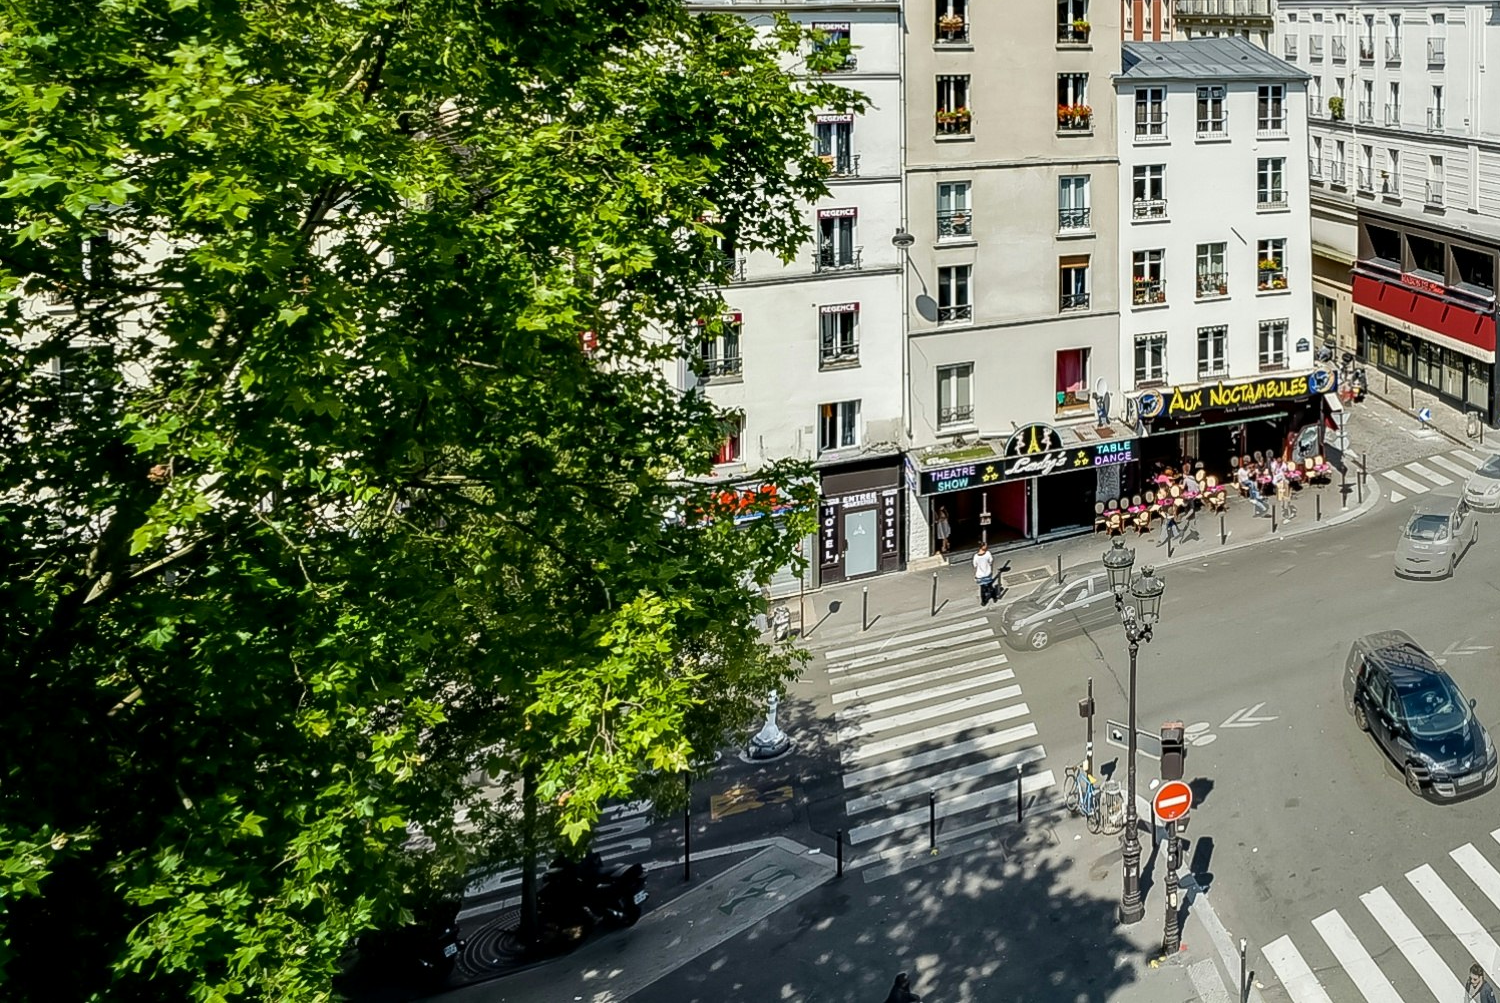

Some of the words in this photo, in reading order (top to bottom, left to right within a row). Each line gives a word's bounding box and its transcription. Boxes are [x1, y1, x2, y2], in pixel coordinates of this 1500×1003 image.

[820, 208, 855, 218] REGENCE
[821, 303, 856, 314] REGENCE
[1168, 387, 1203, 416] AUX
[1209, 376, 1309, 407] NOCTAMBULES
[1096, 440, 1132, 454] TABLE
[1094, 451, 1133, 467] DANCE
[930, 466, 977, 483] THEATRE
[937, 477, 970, 493] SHOW
[884, 496, 895, 549] HOTEL
